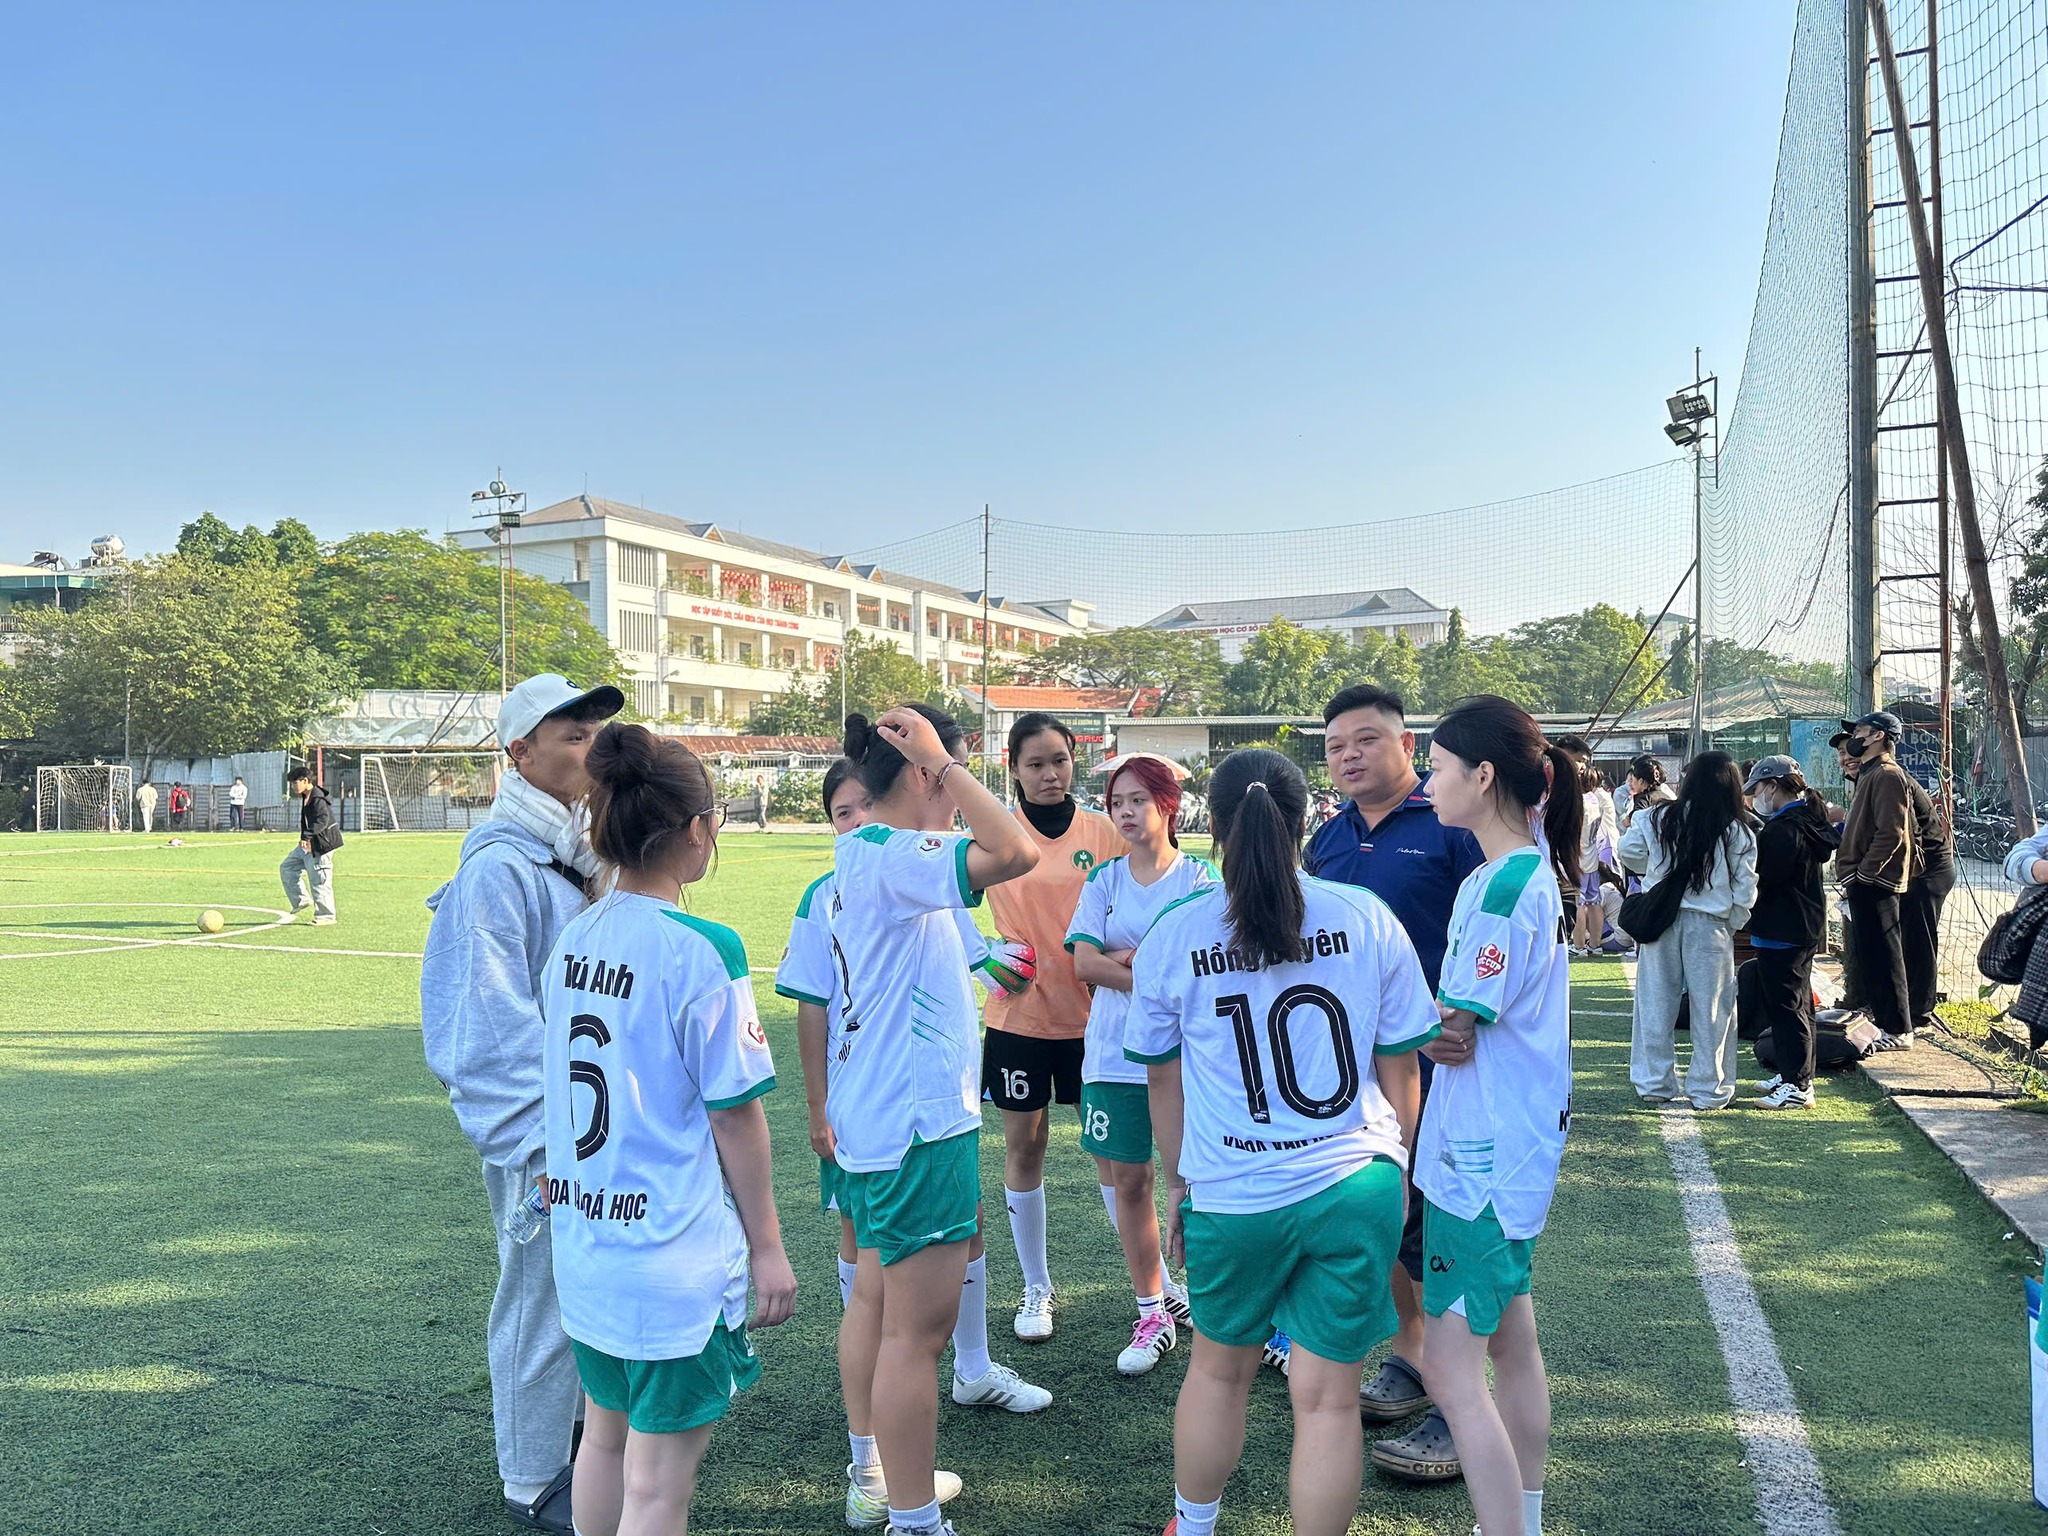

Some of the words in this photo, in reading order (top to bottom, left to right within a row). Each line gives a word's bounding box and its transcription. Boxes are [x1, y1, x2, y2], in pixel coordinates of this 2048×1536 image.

[1268, 928, 1350, 966] yên
[563, 954, 588, 991] Tú
[589, 959, 634, 1000] Anh
[1214, 983, 1360, 1124] 10
[569, 1013, 612, 1162] 6
[1001, 1067, 1030, 1100] 16
[1084, 1102, 1110, 1142] 18
[608, 1192, 648, 1227] HỌC
